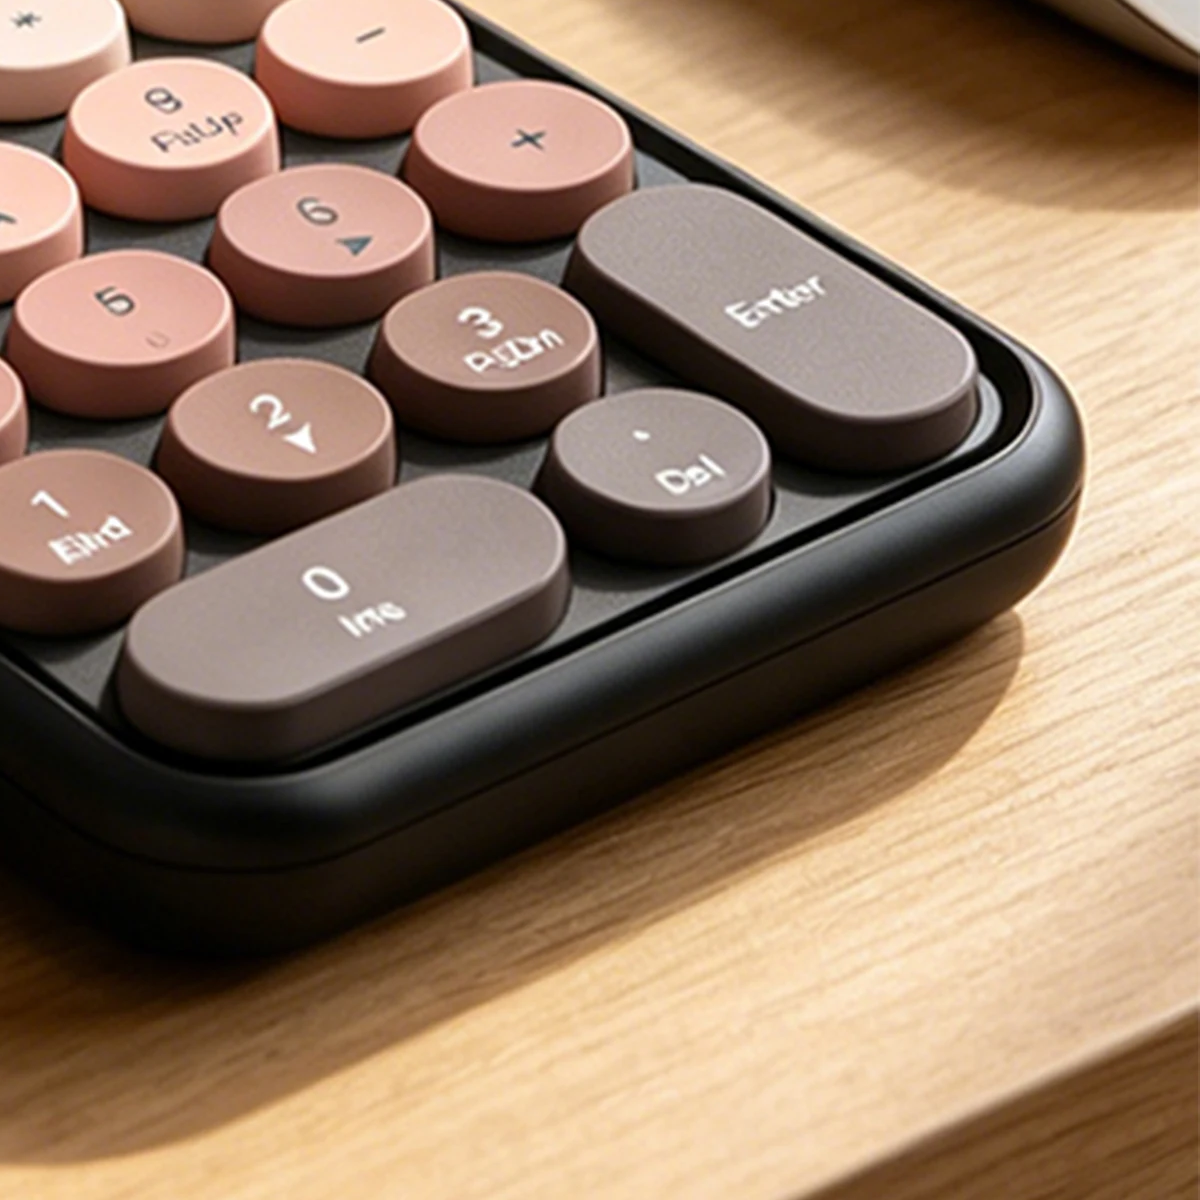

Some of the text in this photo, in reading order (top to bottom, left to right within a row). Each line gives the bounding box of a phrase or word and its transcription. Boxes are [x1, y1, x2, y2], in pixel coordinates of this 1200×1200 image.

[296, 197, 338, 226] 6
[457, 306, 503, 338] 3
[250, 394, 291, 429] 2
[31, 489, 69, 518] 1
[302, 566, 349, 599] 0
